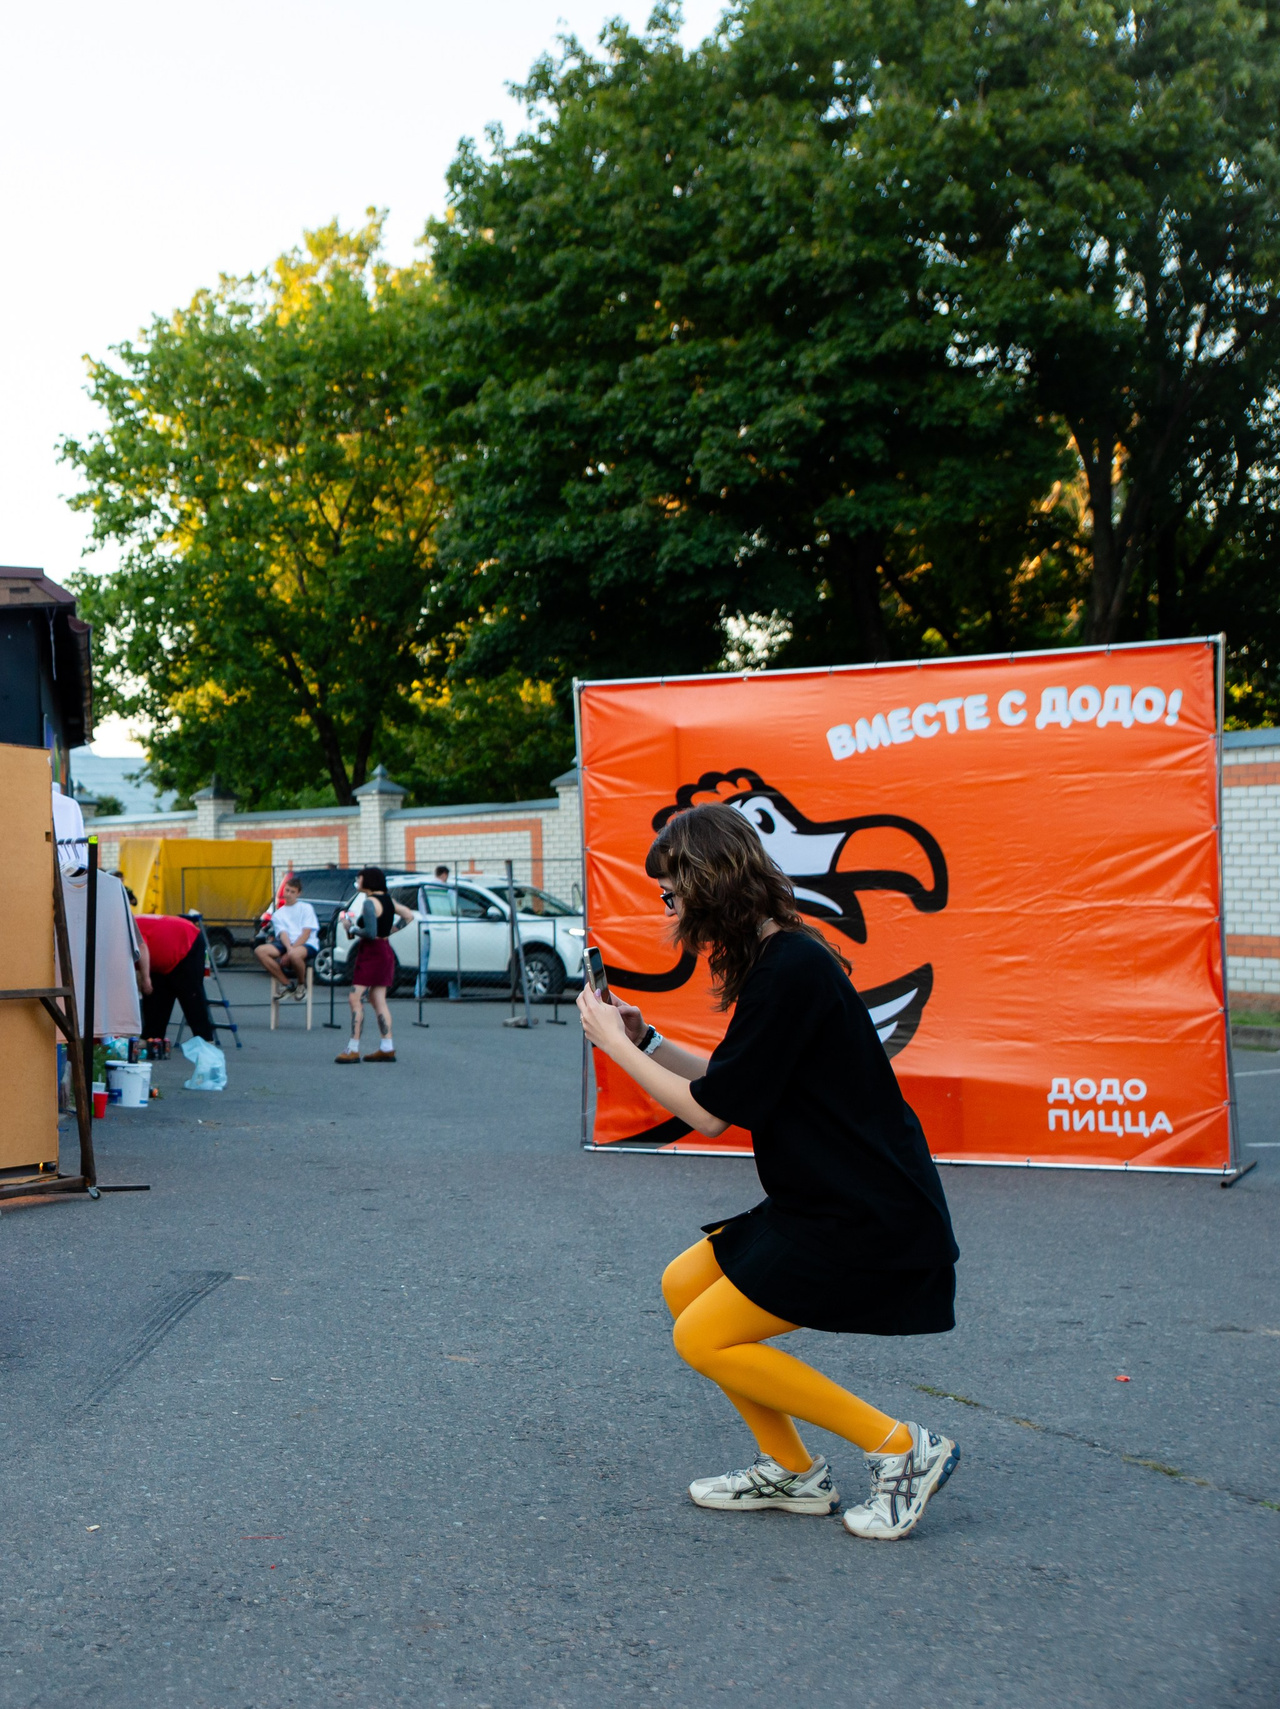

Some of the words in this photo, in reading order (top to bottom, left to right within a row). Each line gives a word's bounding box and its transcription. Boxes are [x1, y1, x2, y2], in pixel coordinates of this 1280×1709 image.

[825, 693, 991, 761] ВМЕСТЕ
[998, 690, 1027, 726] С
[1035, 685, 1183, 729] ДОДО!
[1047, 1077, 1148, 1105] ДОДО
[1047, 1108, 1174, 1138] ПИЦЦА
